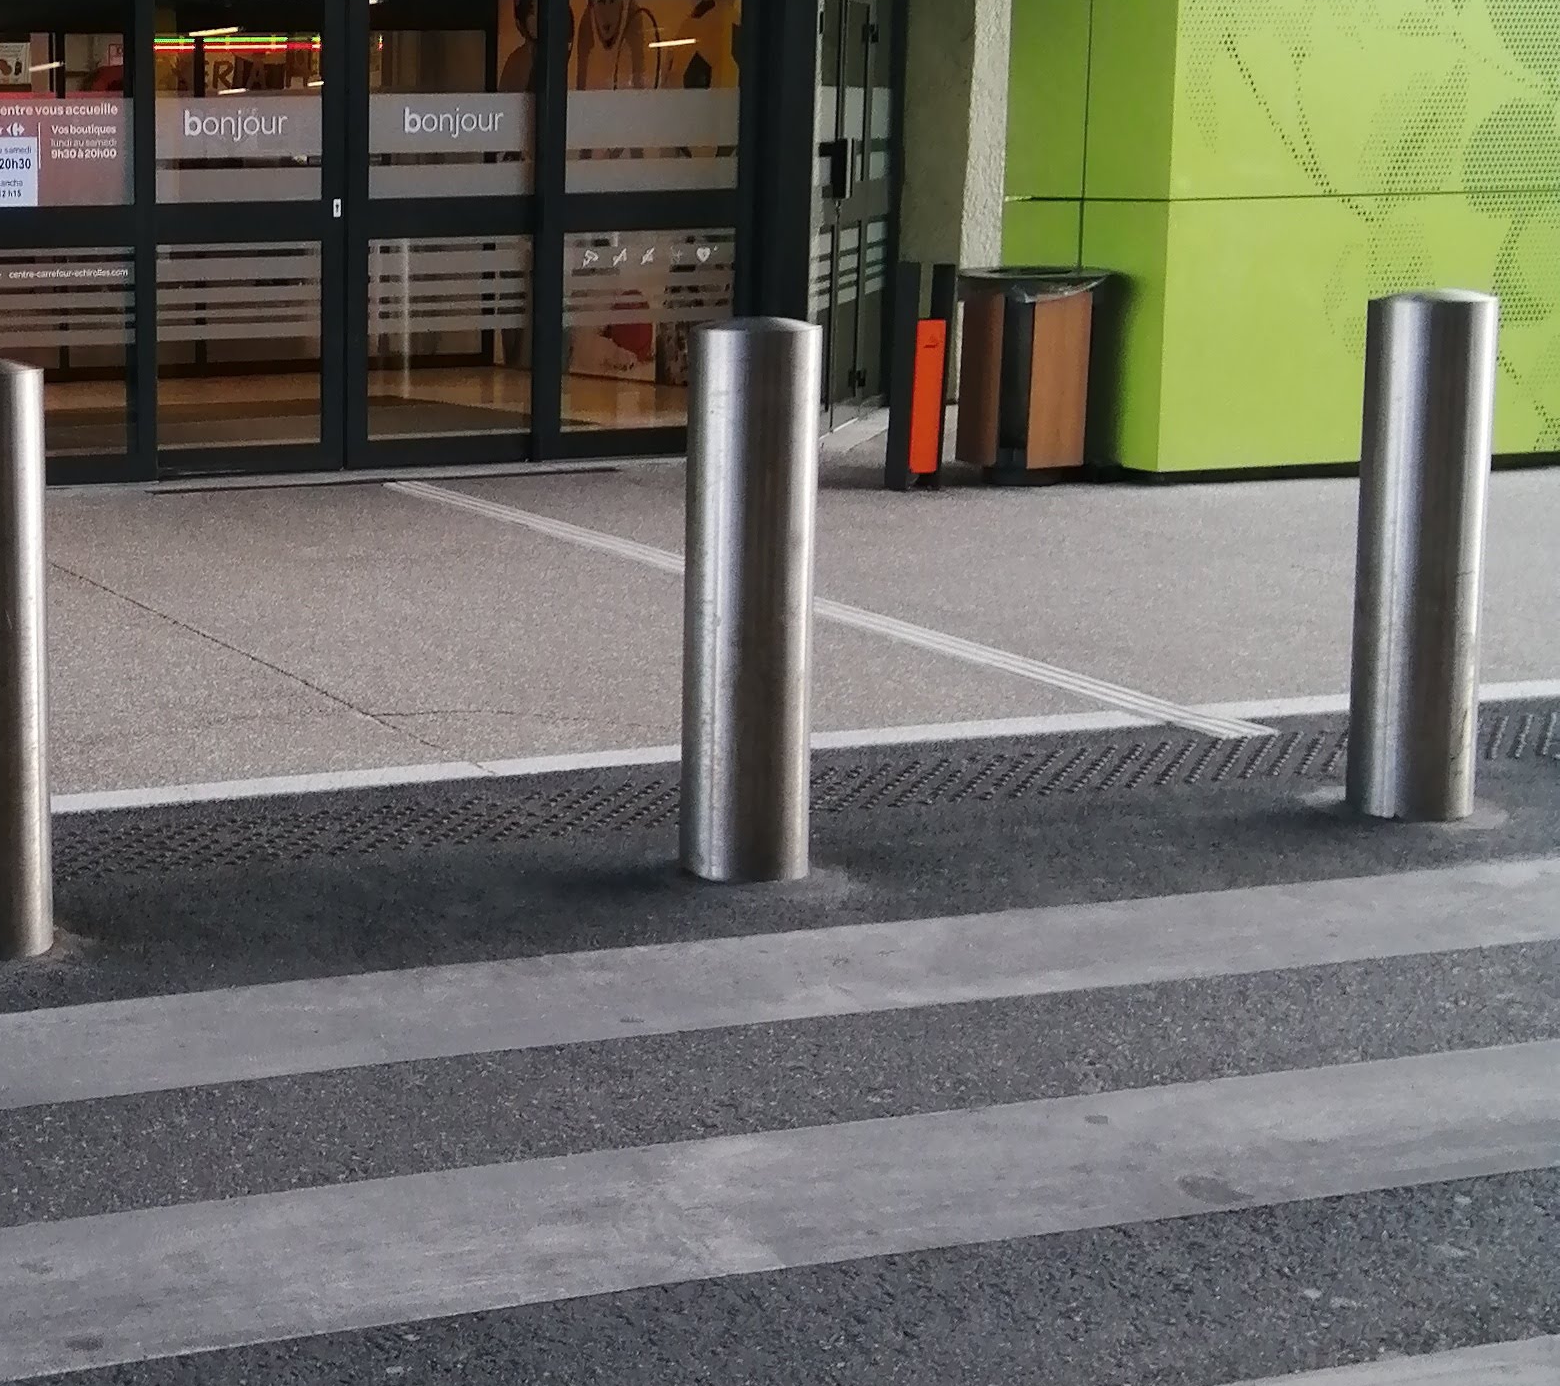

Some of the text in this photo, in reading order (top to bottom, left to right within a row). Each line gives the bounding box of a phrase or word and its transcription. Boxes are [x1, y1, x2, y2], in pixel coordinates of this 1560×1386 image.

[35, 106, 64, 116] vous
[65, 103, 118, 115] accueille
[184, 109, 288, 142] bonjour
[404, 106, 504, 138] bonjour
[51, 124, 117, 136] Vos boutiques
[4, 145, 32, 154] samedi
[51, 149, 77, 159] 9h30
[84, 148, 117, 159] 20h00
[9, 269, 129, 279] centre-carrefour-echirolles.com
